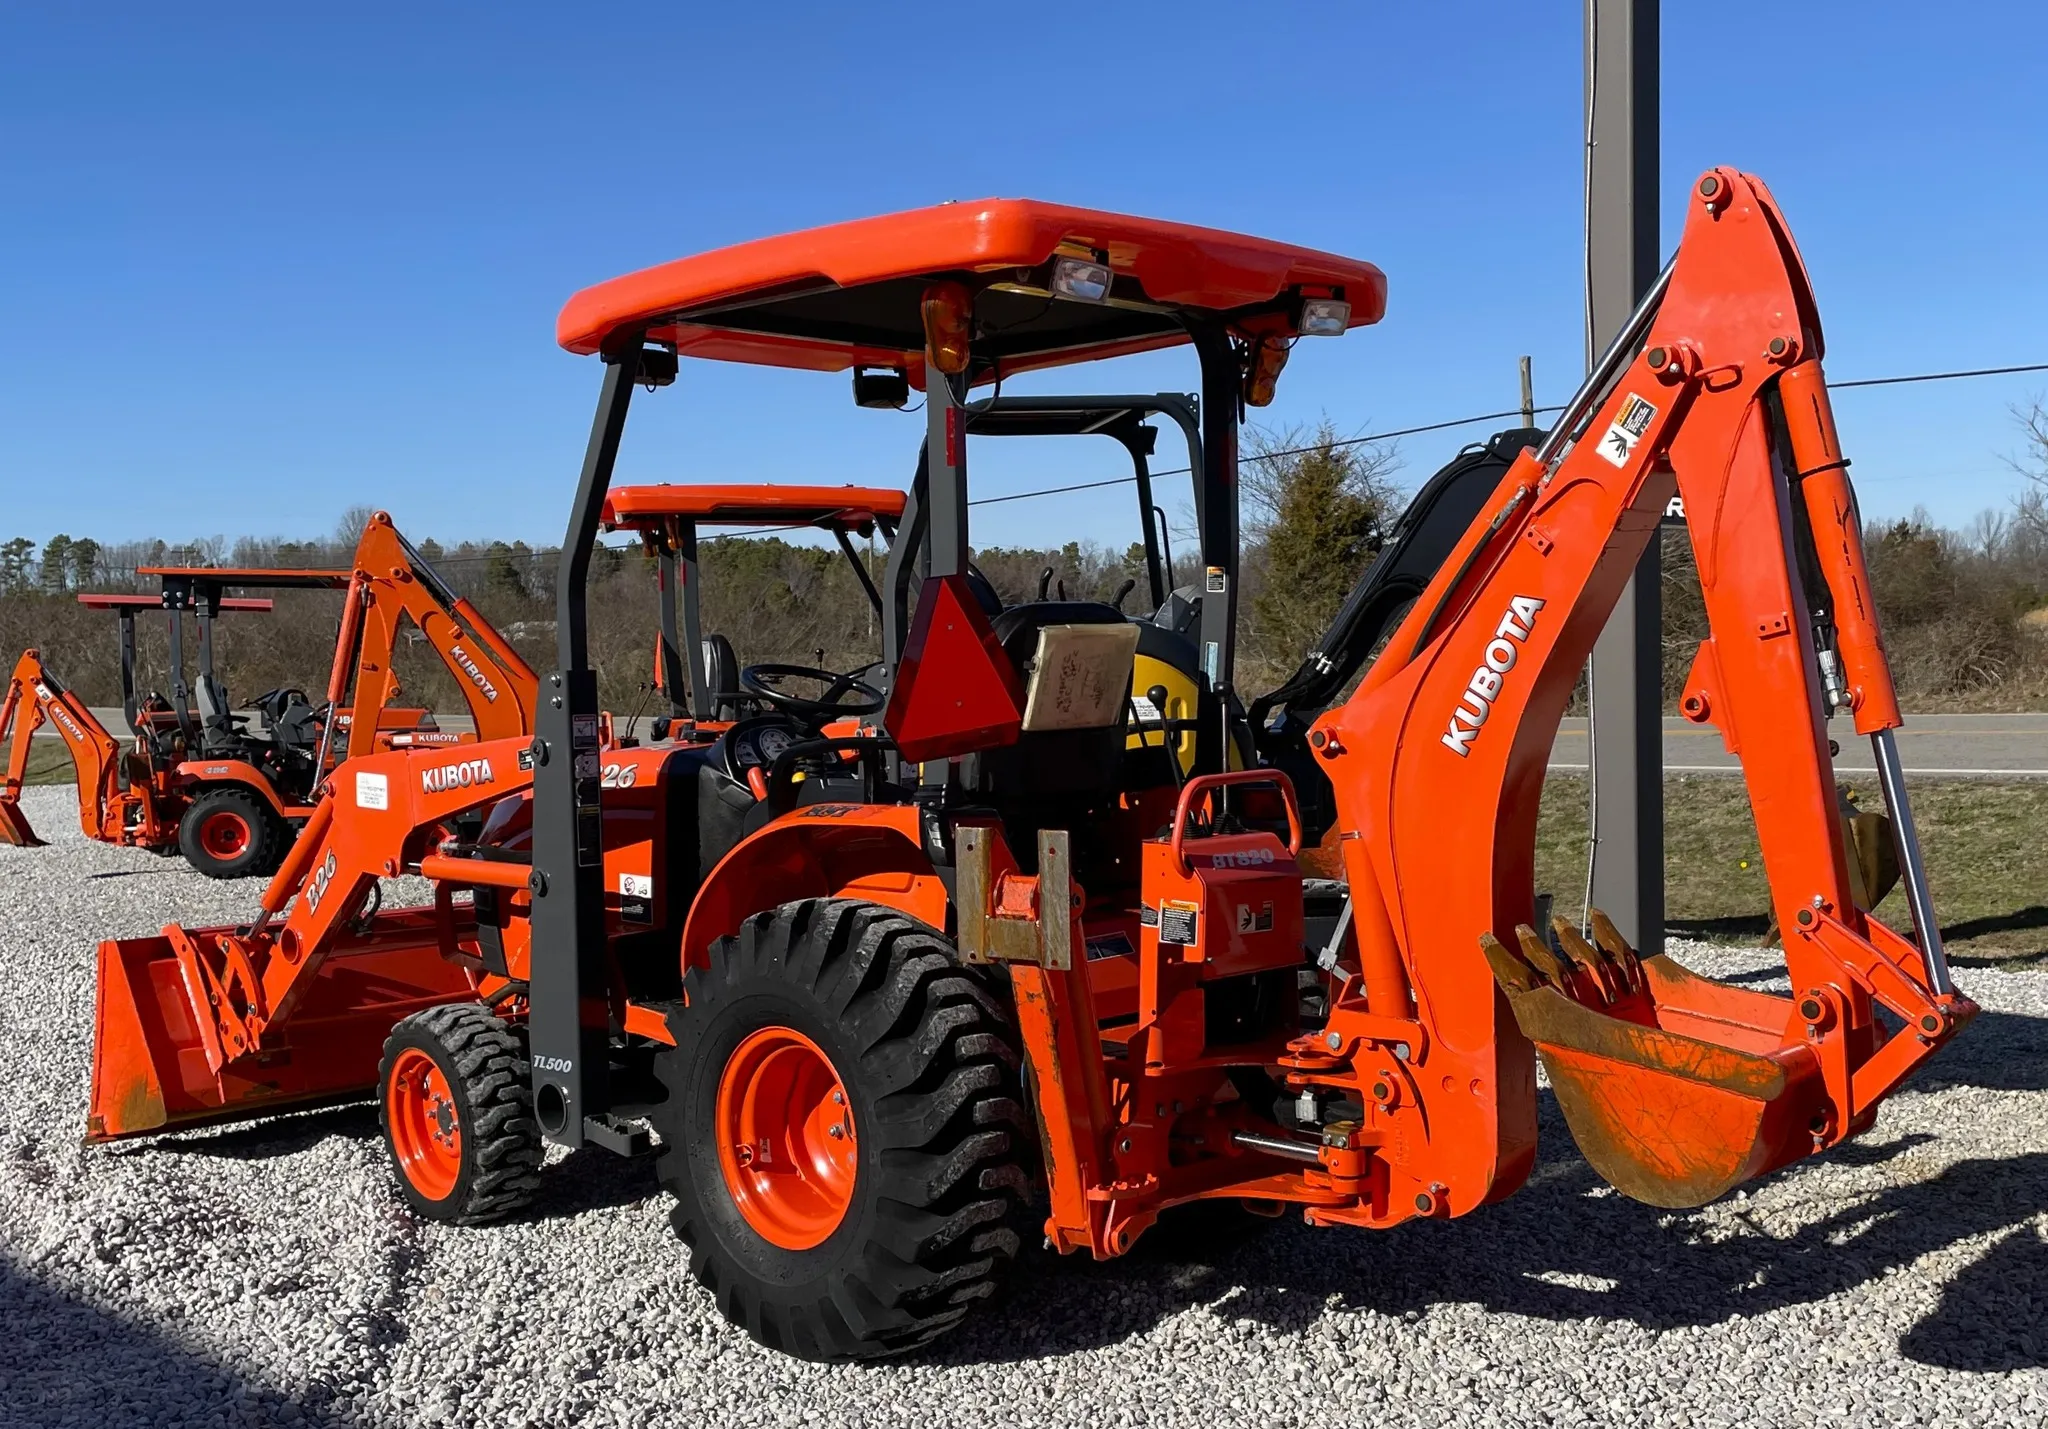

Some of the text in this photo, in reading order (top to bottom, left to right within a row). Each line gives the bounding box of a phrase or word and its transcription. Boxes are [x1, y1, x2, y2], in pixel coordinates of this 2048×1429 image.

[1662, 497, 1686, 517] R
[449, 645, 498, 703] KUBOTA
[1440, 595, 1547, 758] KUBOTA
[53, 706, 84, 742] KUBOTA
[418, 734, 459, 743] KUBOTA
[421, 758, 494, 794] KUBOTA
[600, 763, 639, 788] 26
[1212, 848, 1275, 868] BT820
[306, 845, 337, 917] B26
[533, 1054, 573, 1073] TL500
